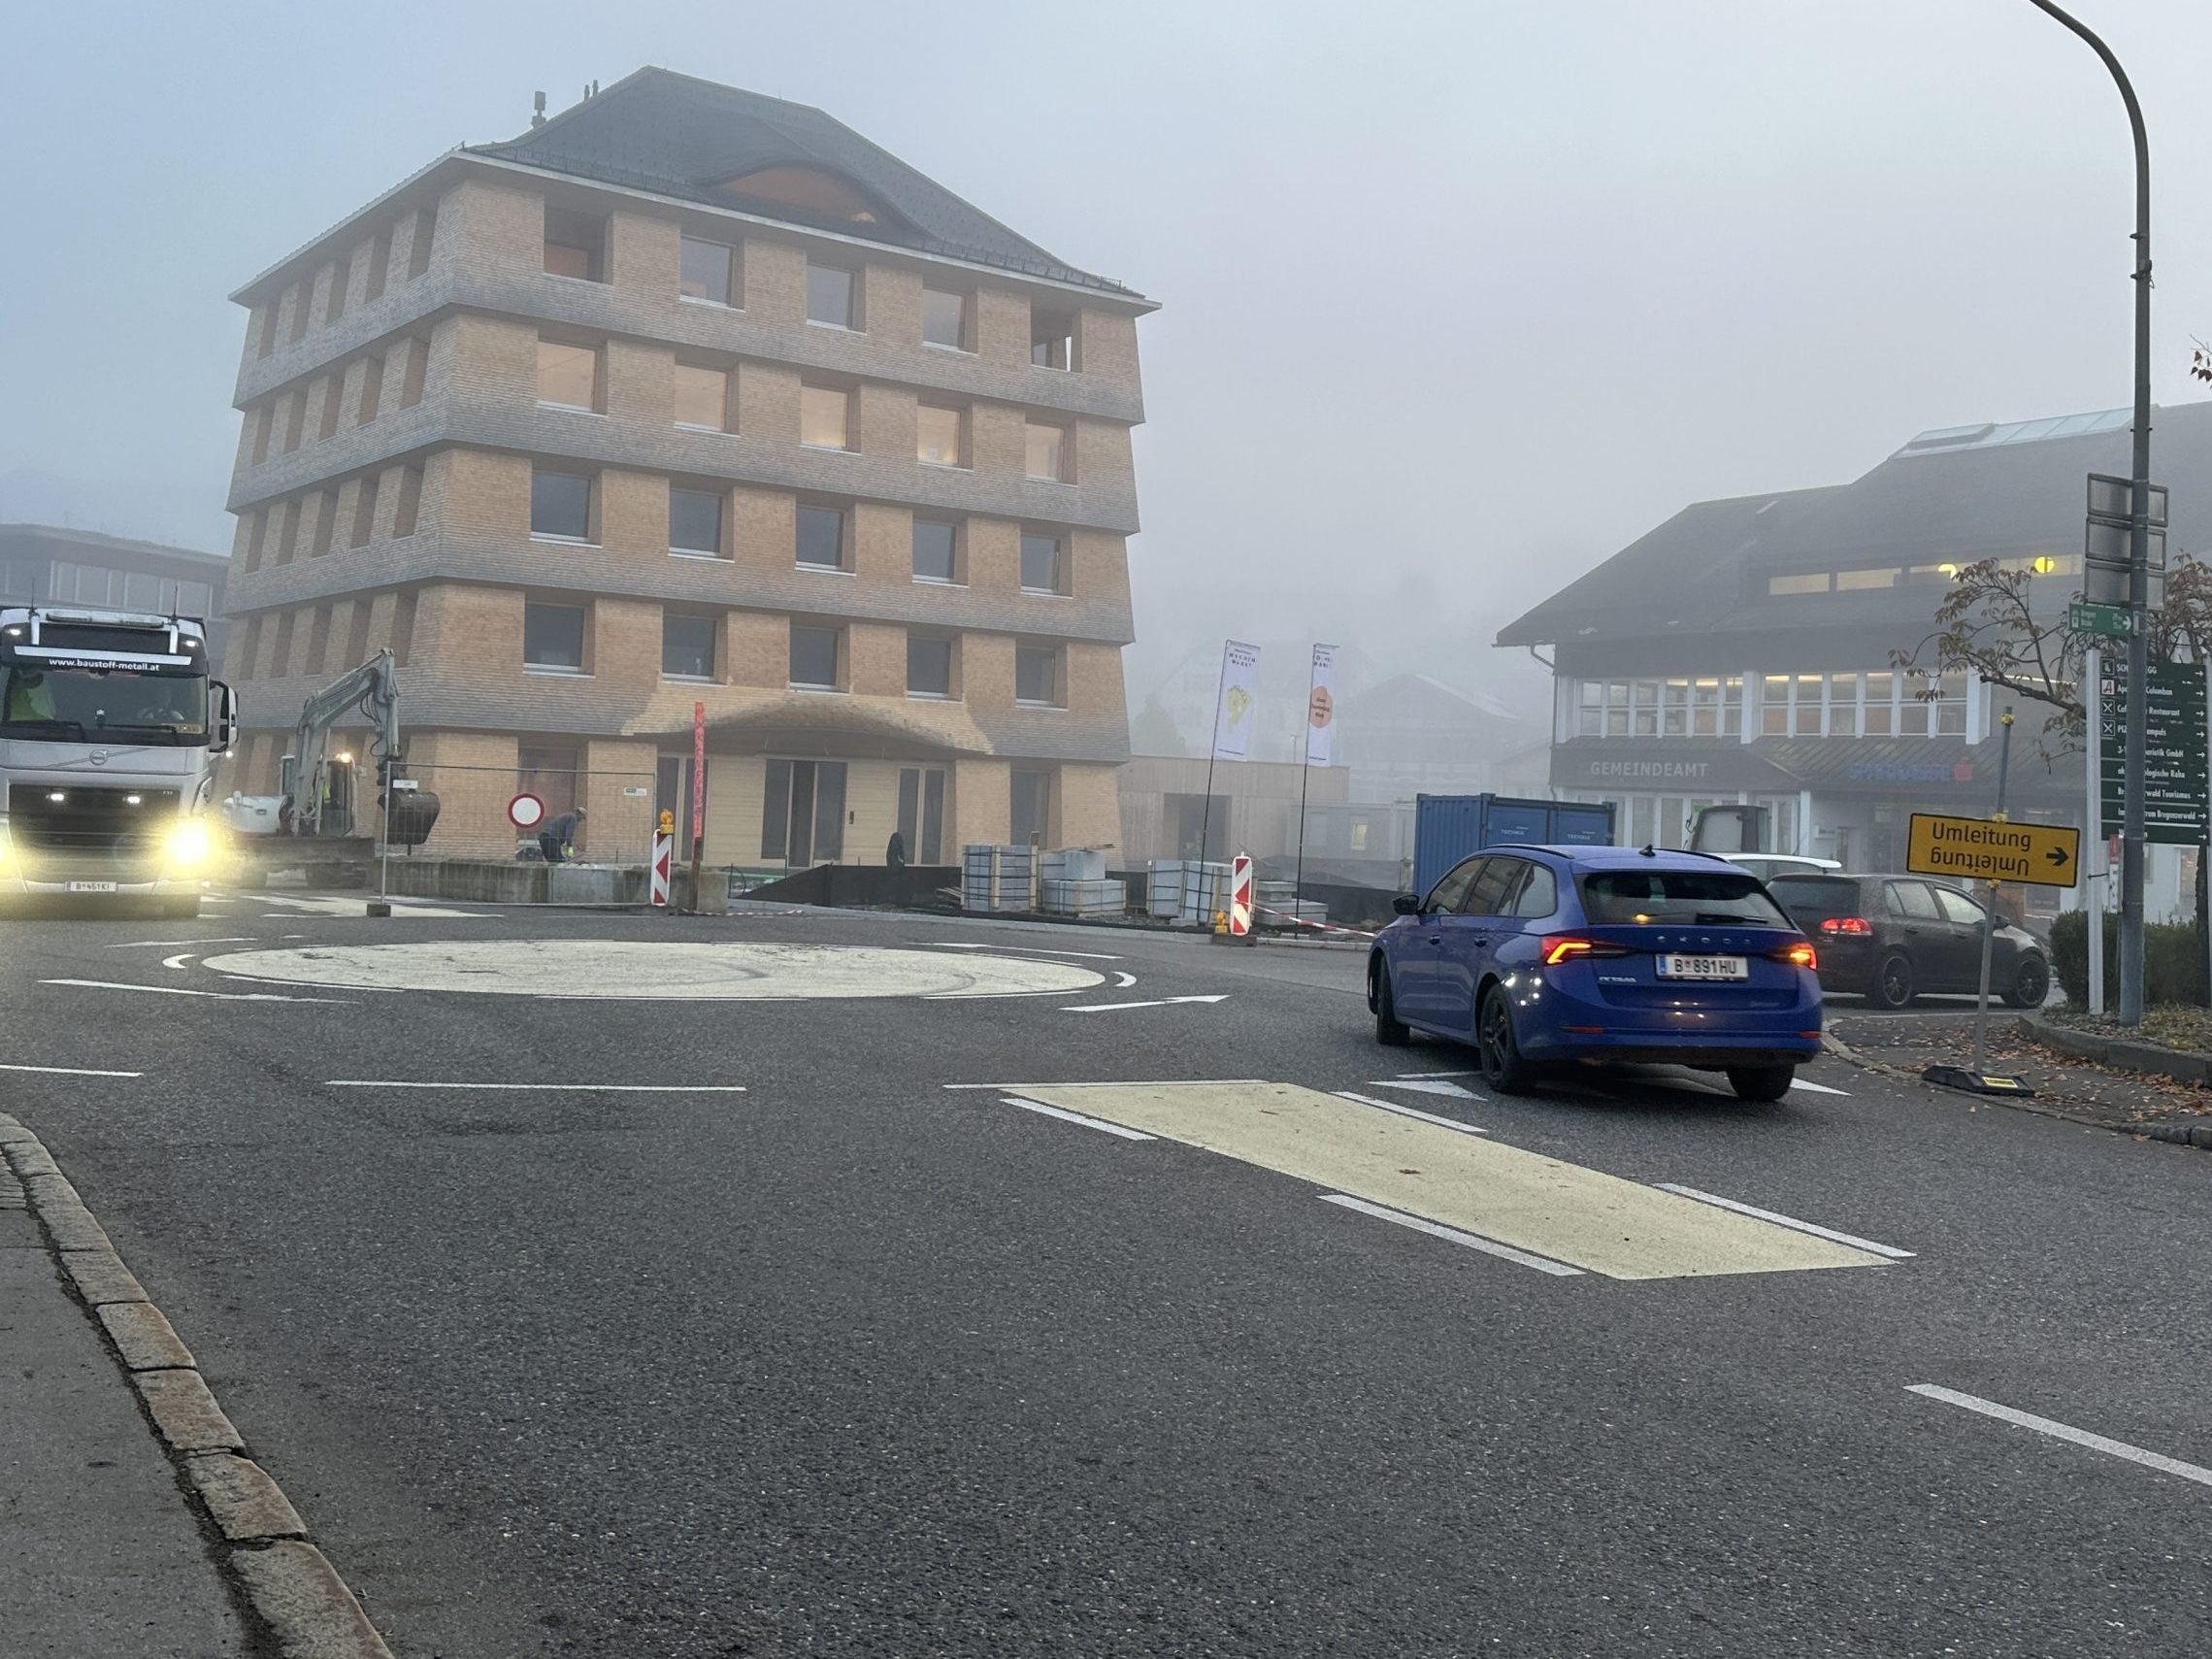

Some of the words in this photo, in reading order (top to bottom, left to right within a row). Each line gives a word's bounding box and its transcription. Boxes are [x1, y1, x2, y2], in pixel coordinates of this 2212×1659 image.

[49, 658, 160, 672] www.baustoff-metall.at
[2148, 706, 2180, 716] Restaurant
[2165, 748, 2184, 758] GmbH
[1590, 761, 1709, 778] GEMEINDEAMT
[2162, 788, 2192, 799] Tourismus
[2157, 809, 2196, 821] Bregenzerwald
[1931, 822, 2031, 852] Umleitung
[1931, 846, 2030, 877] Umleitung
[1693, 959, 1736, 974] 891HU
